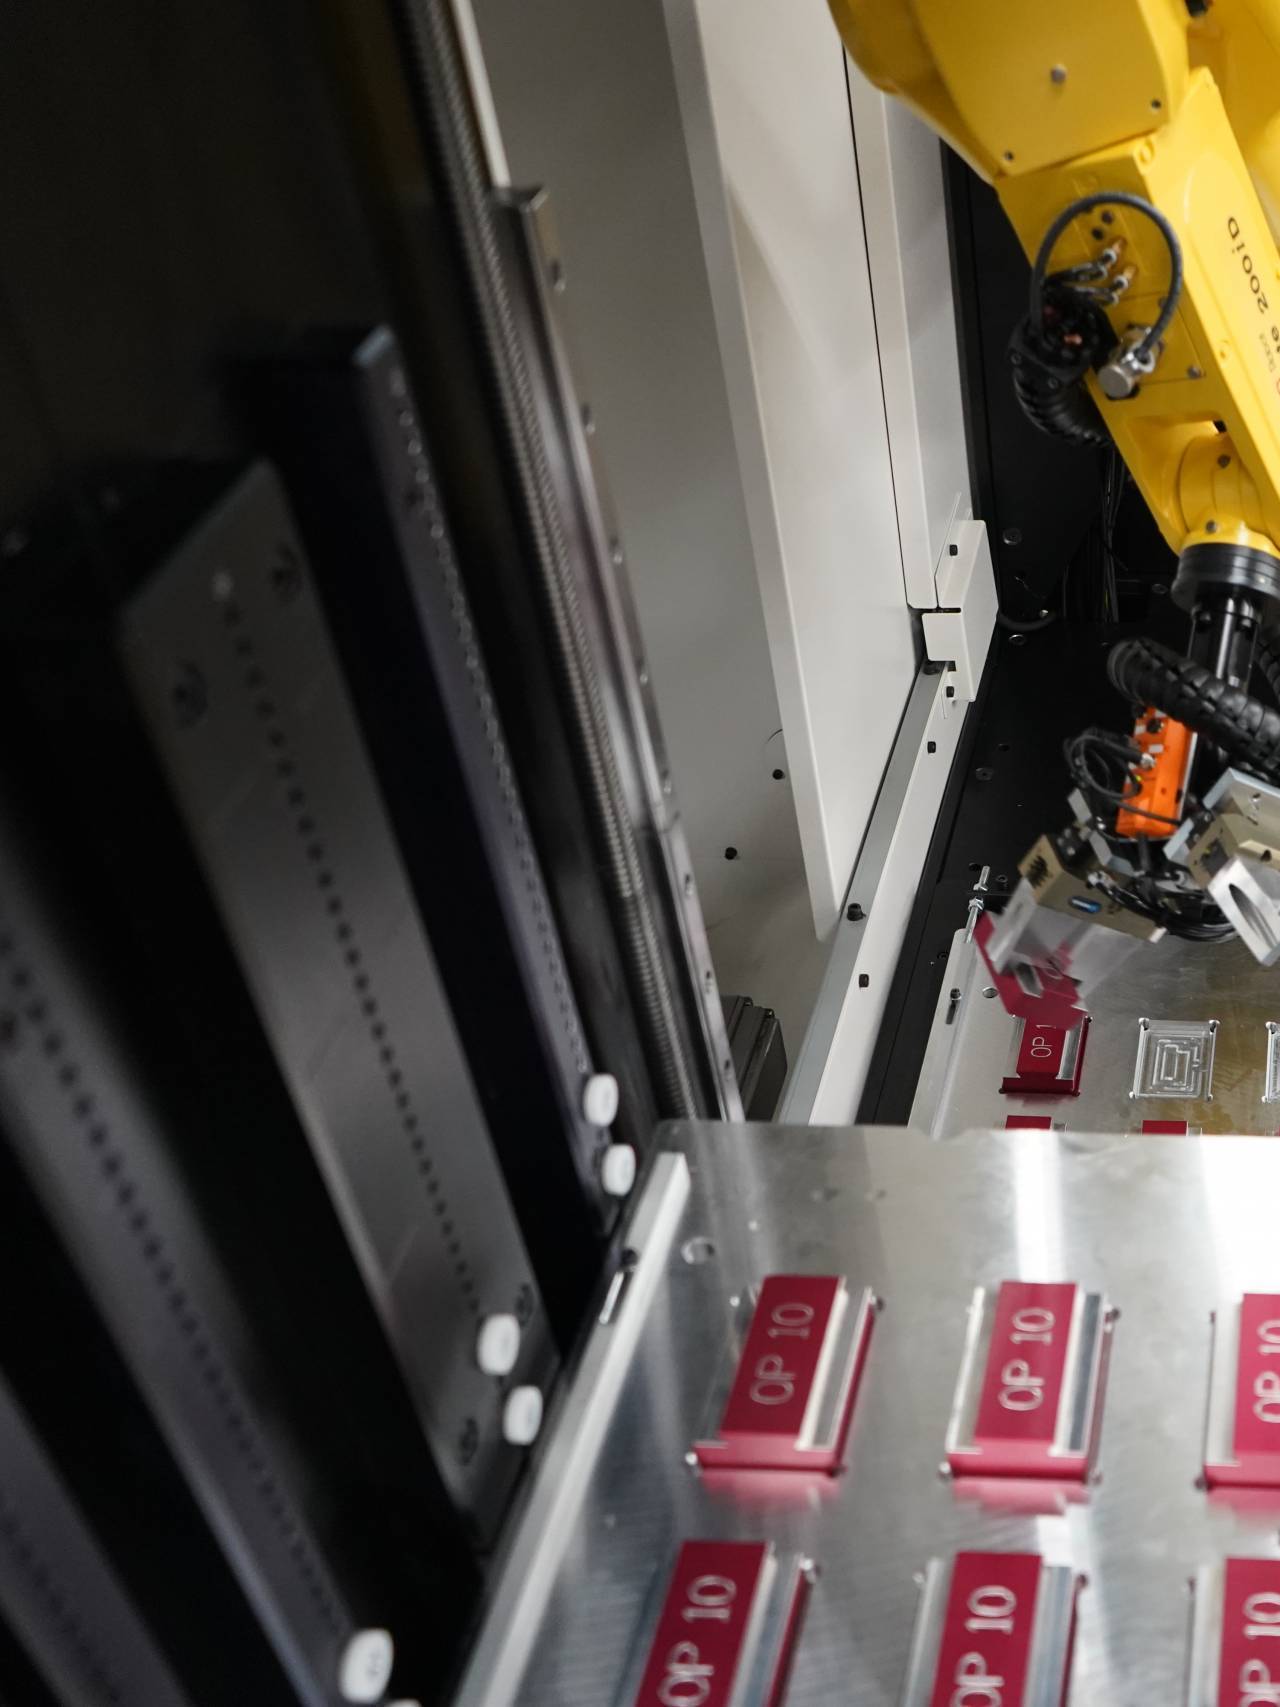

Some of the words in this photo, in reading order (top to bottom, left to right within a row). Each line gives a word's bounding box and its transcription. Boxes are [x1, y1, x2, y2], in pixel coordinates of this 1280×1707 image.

[1030, 1036, 1053, 1058] OP
[768, 1302, 814, 1339] 10
[1010, 1307, 1056, 1345] 10
[749, 1355, 796, 1405] OP
[998, 1360, 1044, 1412] OP
[683, 1574, 737, 1622] 10
[964, 1585, 1017, 1634] 10
[658, 1641, 714, 1707] OP
